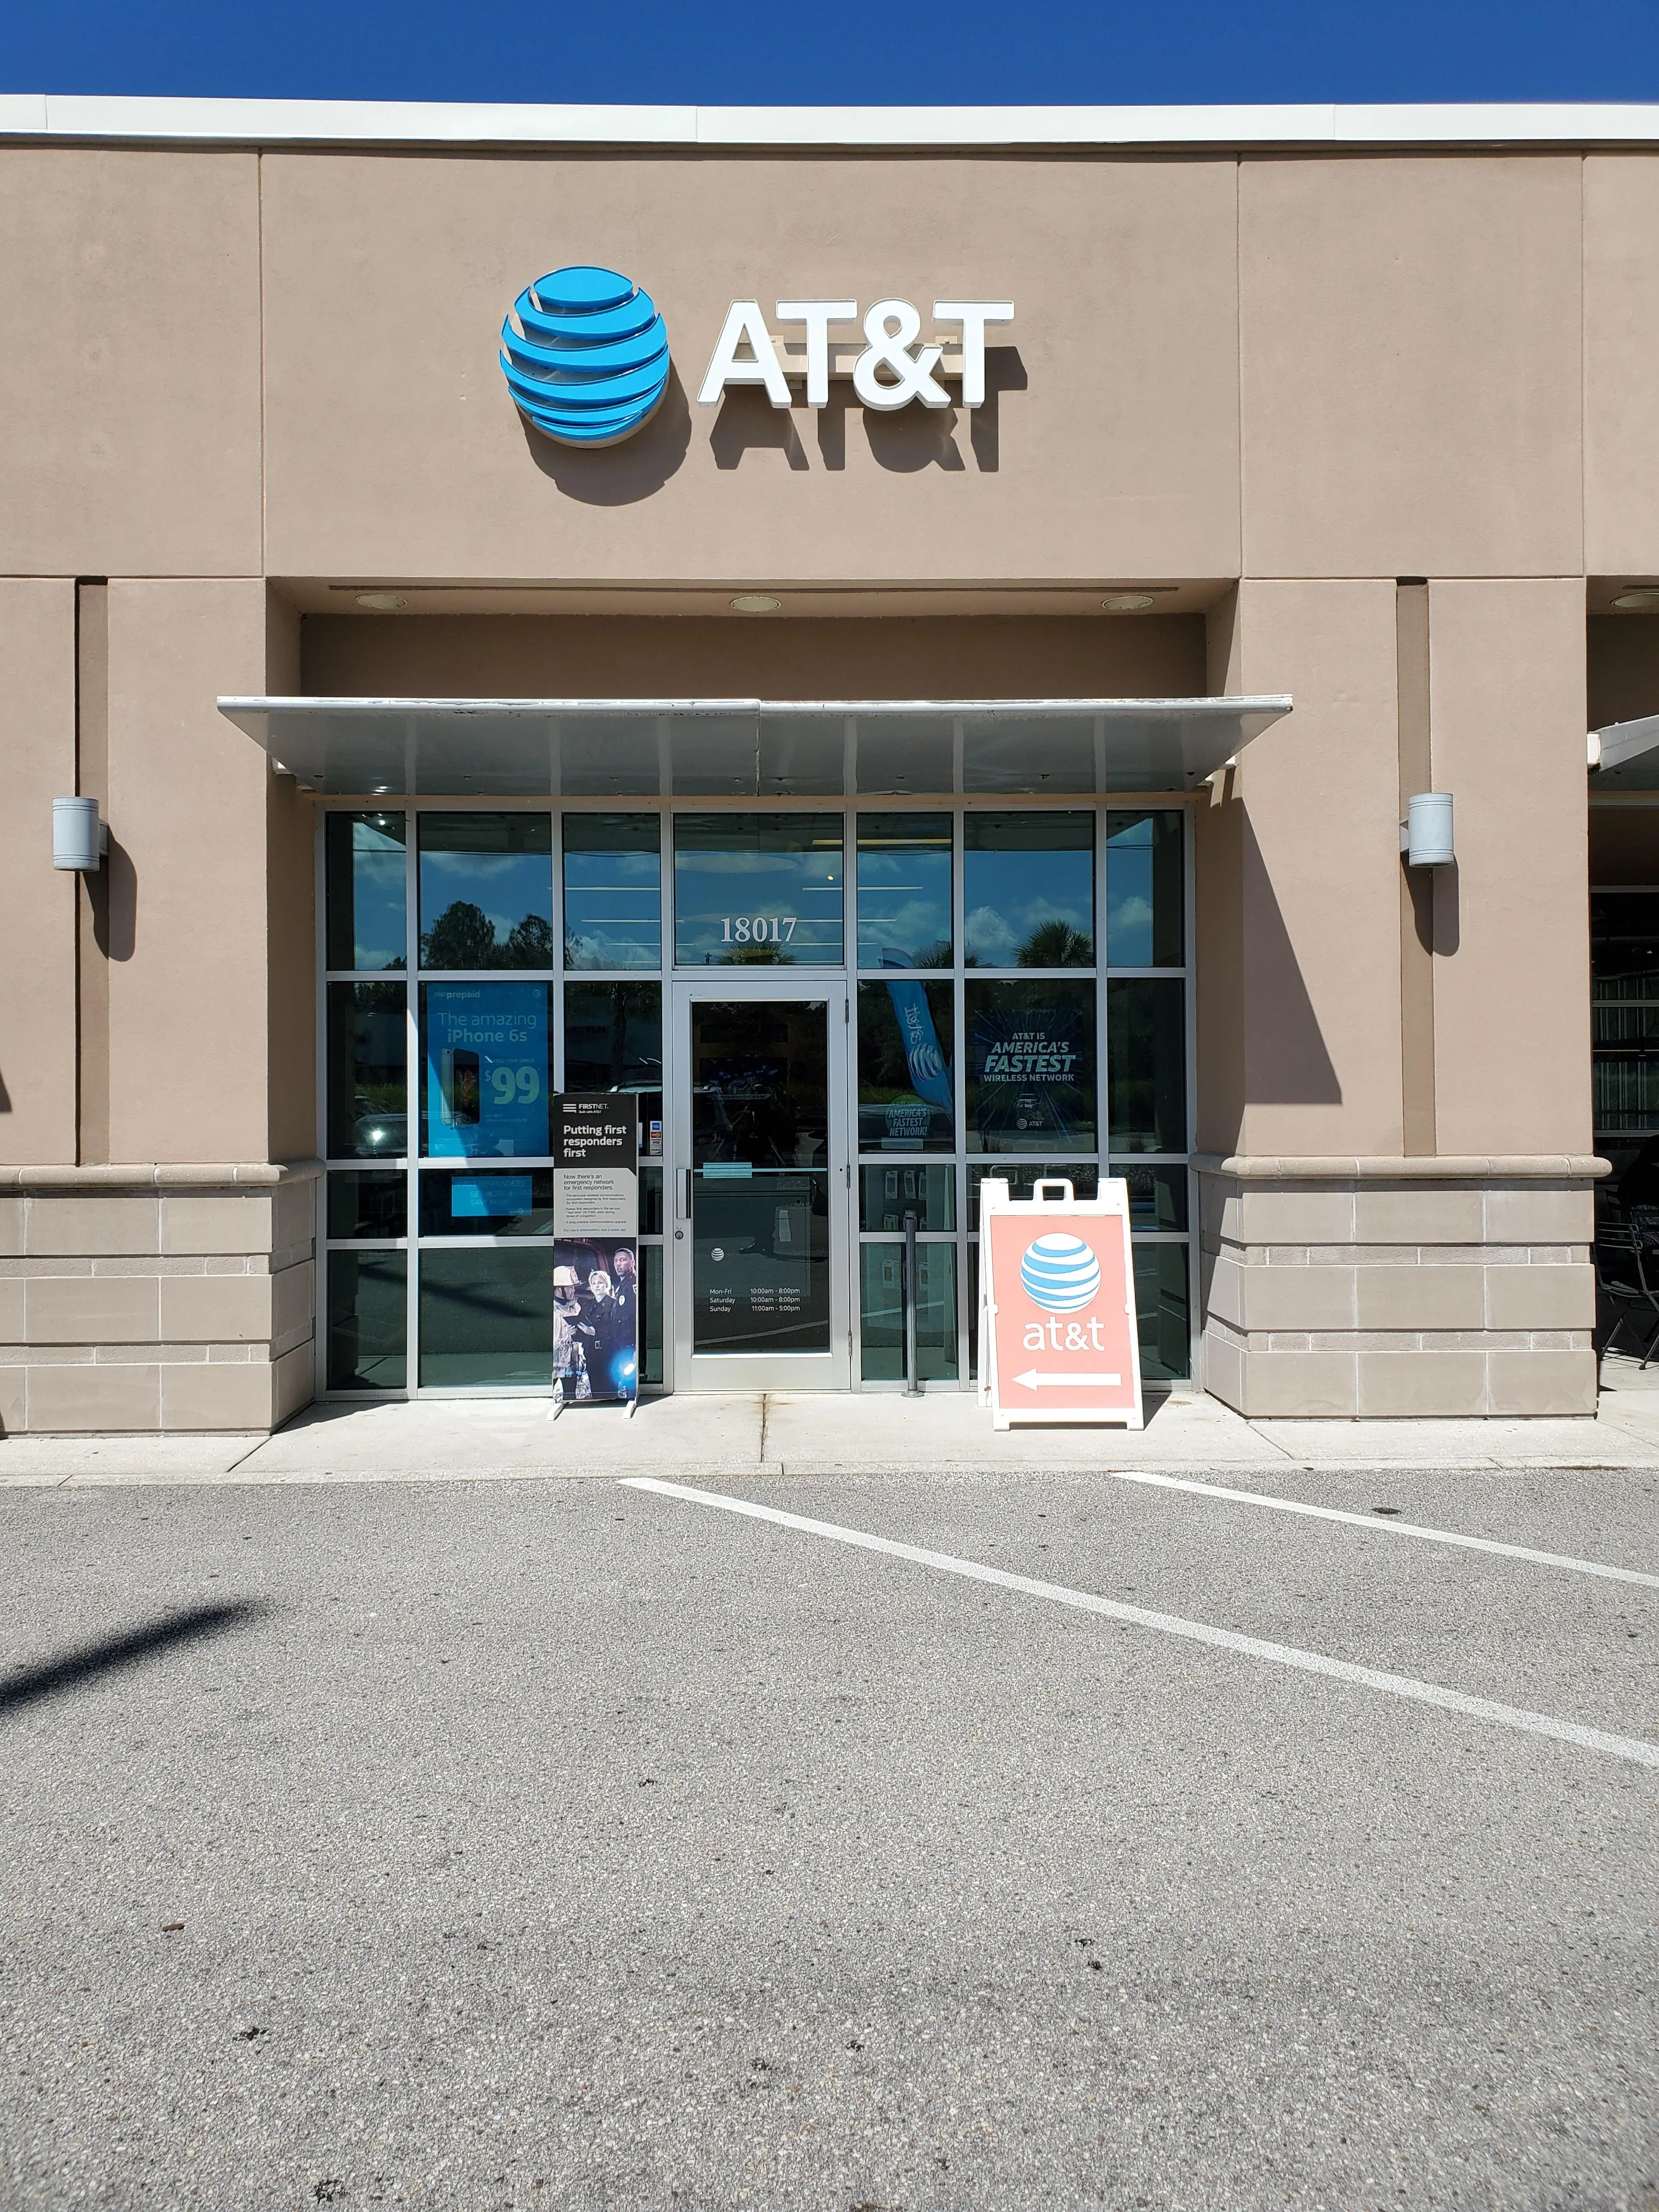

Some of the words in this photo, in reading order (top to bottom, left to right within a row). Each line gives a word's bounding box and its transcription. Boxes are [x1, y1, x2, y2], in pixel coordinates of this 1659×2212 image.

[696, 297, 1014, 410] AT&T
[720, 917, 797, 943] 18017
[446, 990, 481, 1000] prepaid
[437, 1012, 467, 1025] The
[471, 1011, 537, 1029] amazing
[448, 1028, 504, 1042] iPhone
[509, 1029, 528, 1042] 6s
[1012, 1032, 1035, 1040] AT&T
[991, 1042, 1069, 1053] AMERICA'S
[984, 1055, 1076, 1073] FASTEST
[888, 1108, 927, 1118] AMERICA'S
[893, 1118, 924, 1127] FASTEST
[563, 1125, 602, 1136] Putting
[605, 1125, 627, 1134] first
[889, 1126, 928, 1137] NETWORK!
[563, 1136, 623, 1148] responders
[563, 1148, 586, 1157] first
[1023, 1316, 1105, 1352] at&t
